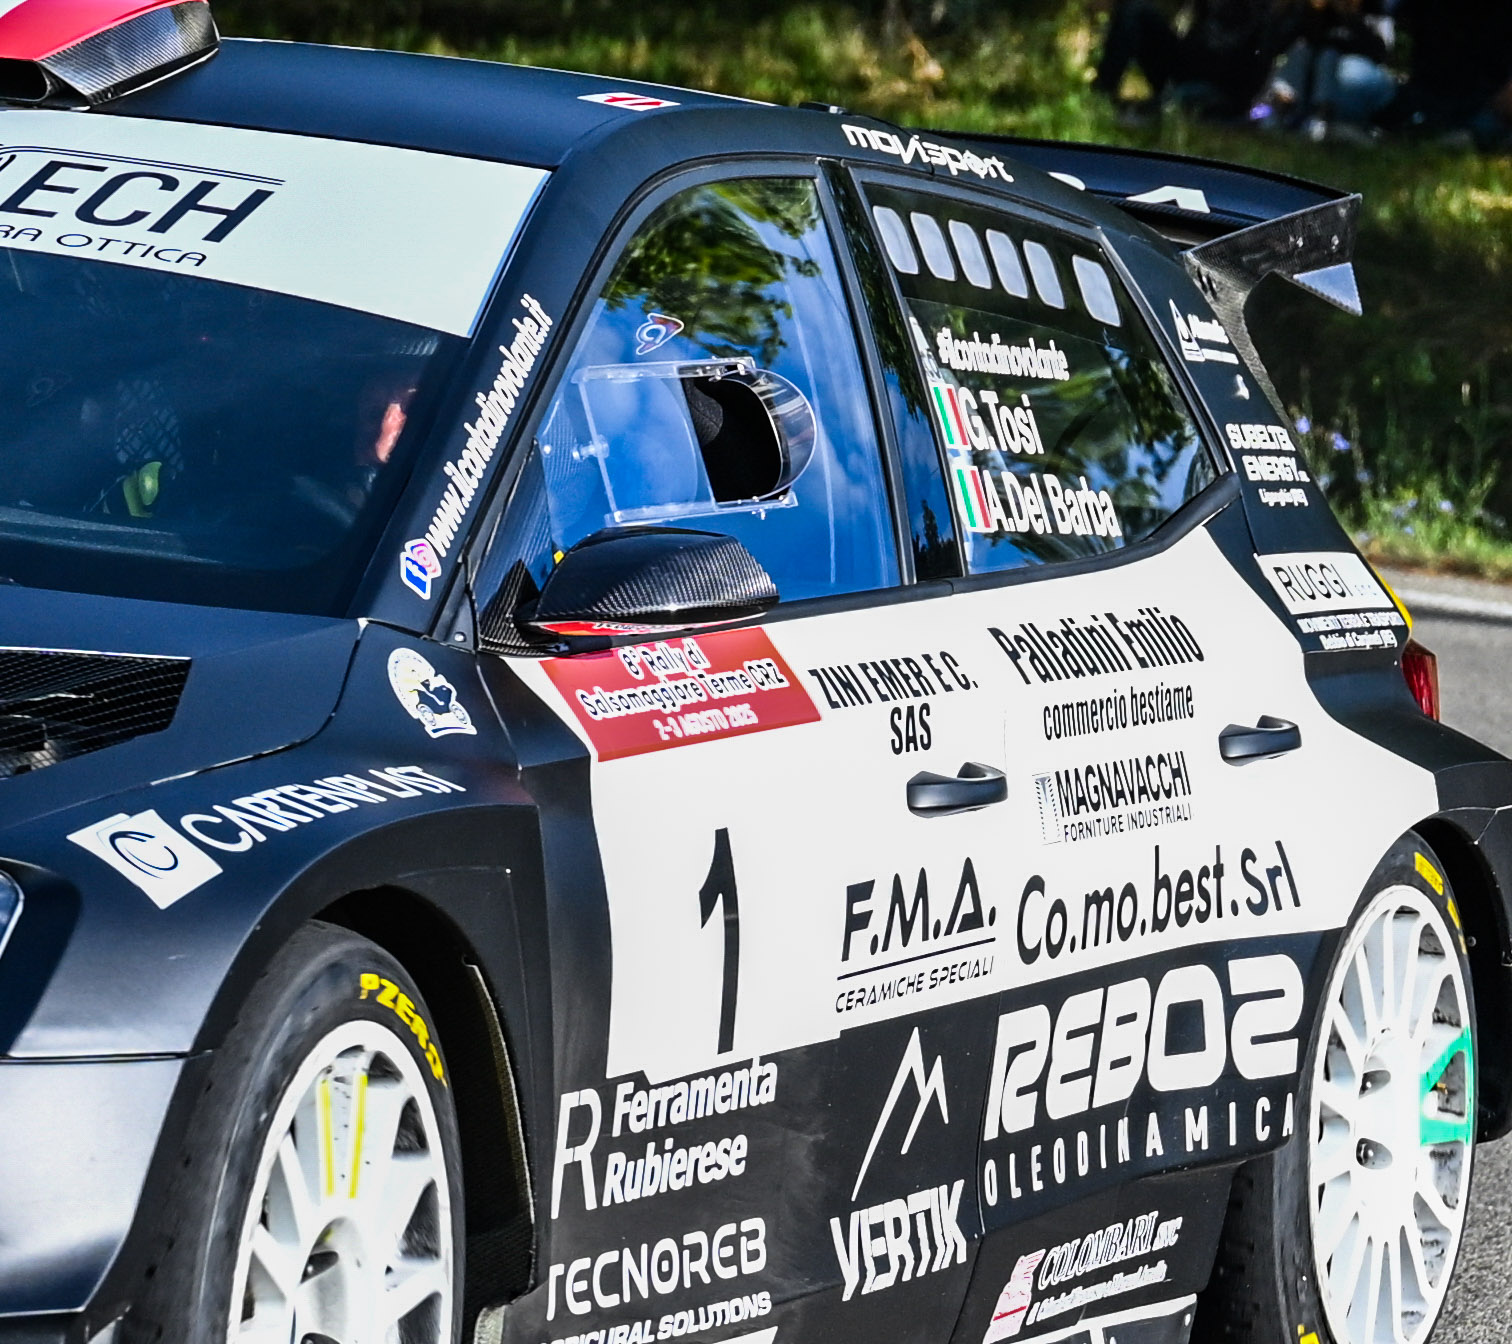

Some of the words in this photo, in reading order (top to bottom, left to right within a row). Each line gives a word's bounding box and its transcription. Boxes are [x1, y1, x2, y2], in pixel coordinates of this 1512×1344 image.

[55, 233, 208, 267] OTTICA
[1242, 455, 1300, 482] ENERGY
[1043, 473, 1122, 537] Barba
[1273, 563, 1353, 602] RUGGI
[641, 641, 689, 673] Rally
[687, 639, 708, 667] di
[987, 614, 1132, 685] Palladini
[1105, 607, 1205, 669] Emilio
[579, 678, 703, 716] Salsomaggiore
[697, 672, 752, 697] Terme
[746, 661, 786, 687] CRZ
[808, 661, 872, 709] ZINI
[858, 657, 933, 703] EMER
[1043, 689, 1128, 740] commercio
[1130, 683, 1195, 727] bestiame
[890, 702, 932, 755] SAS
[179, 765, 466, 852] CARTENPLAST
[1054, 750, 1192, 818] MAGNAVACCHI
[1063, 814, 1124, 843] FORNITURE
[1127, 803, 1192, 833] INDUSTRIALI
[699, 827, 739, 1055] 1
[841, 856, 996, 962] F.M.A.
[835, 967, 925, 1014] CERAMICHE
[927, 956, 994, 990] SPECIALI
[613, 1057, 777, 1137] Ferramenta
[602, 1134, 747, 1207] Rubierese
[984, 1093, 1294, 1206] OLEODINAMICA
[546, 1218, 766, 1321] TECNOREB
[830, 1179, 967, 1302] VERTIK
[1037, 1211, 1159, 1291] COLOMBARI
[657, 1292, 772, 1341] SOLUTIONS
